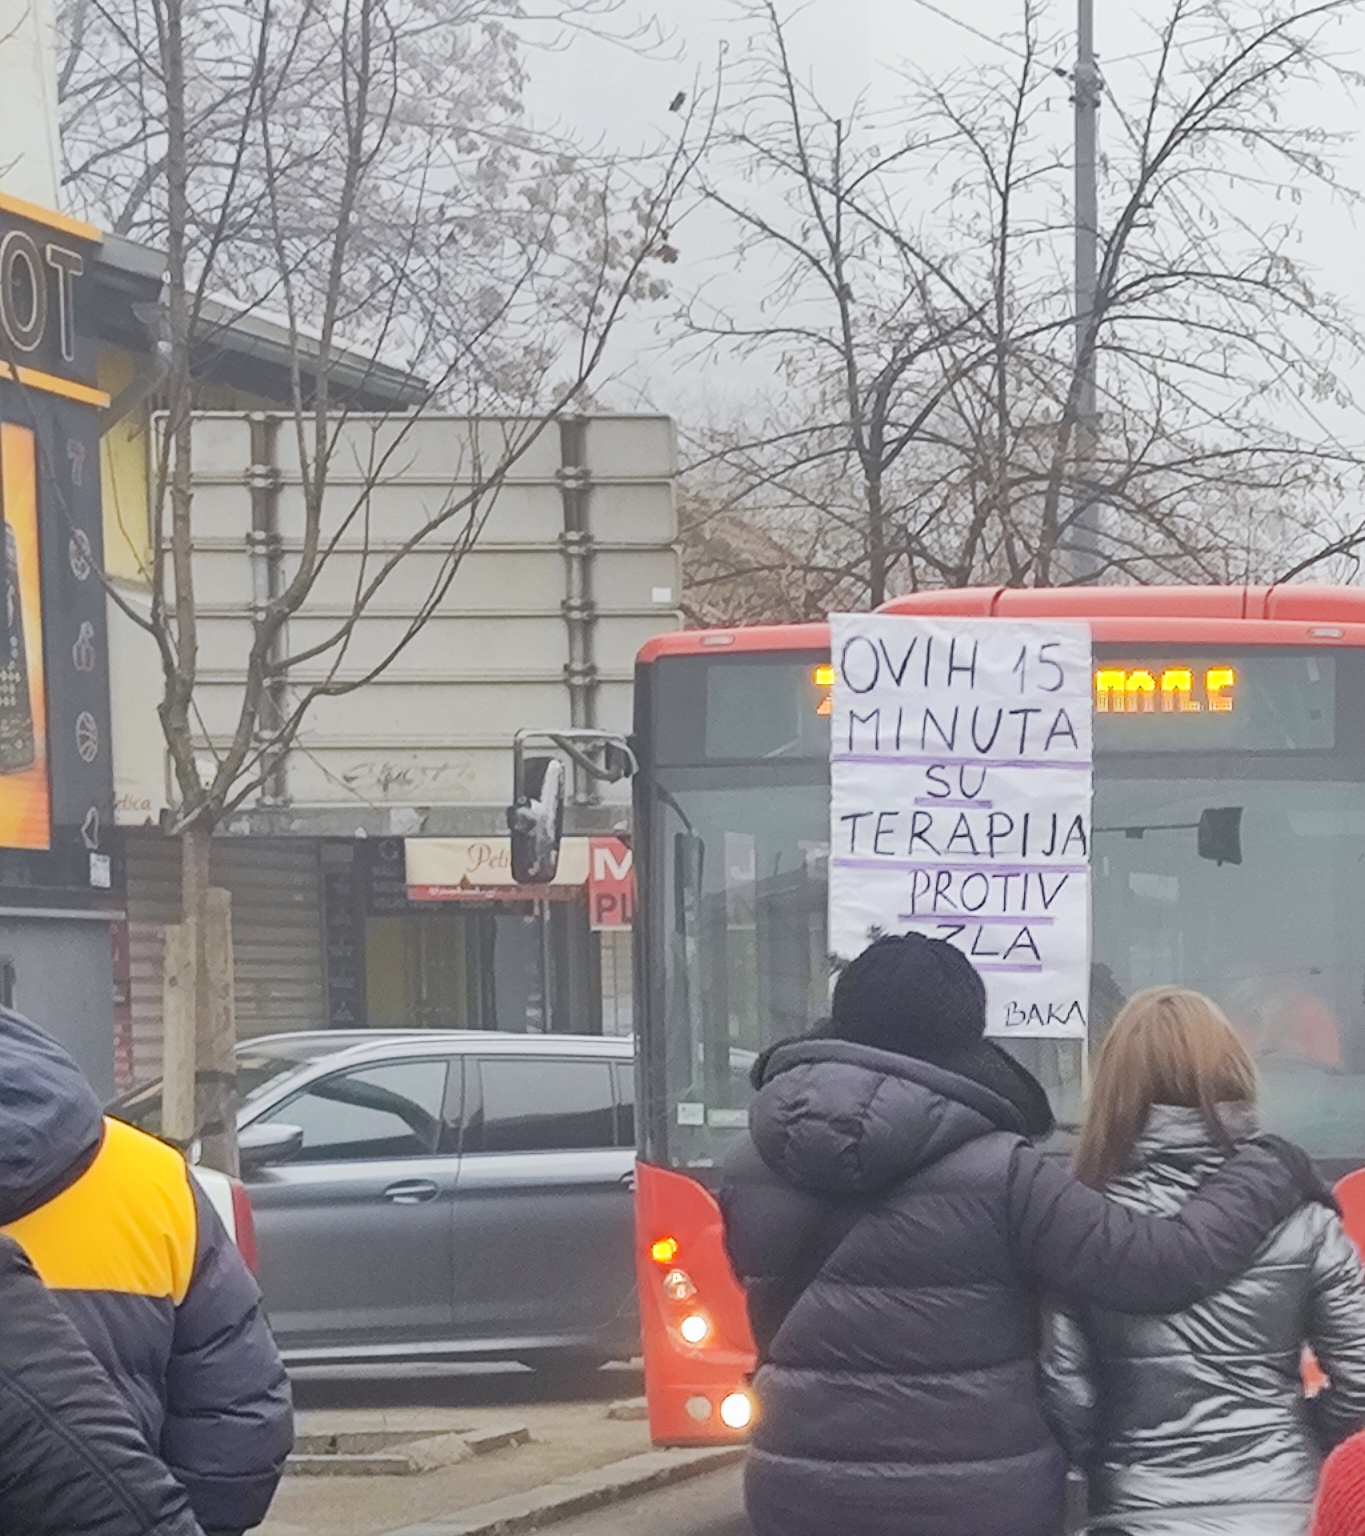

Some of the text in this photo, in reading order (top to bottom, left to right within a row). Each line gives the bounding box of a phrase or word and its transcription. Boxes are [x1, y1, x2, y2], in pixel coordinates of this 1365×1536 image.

[840, 635, 979, 694] OVIH
[1012, 643, 1065, 694] 15
[848, 706, 1079, 754] MINUTA
[925, 762, 987, 800] SU
[840, 811, 1088, 858] TERAPIJA
[911, 871, 1069, 916] PROTIV
[1005, 1000, 1086, 1027] BAKA
